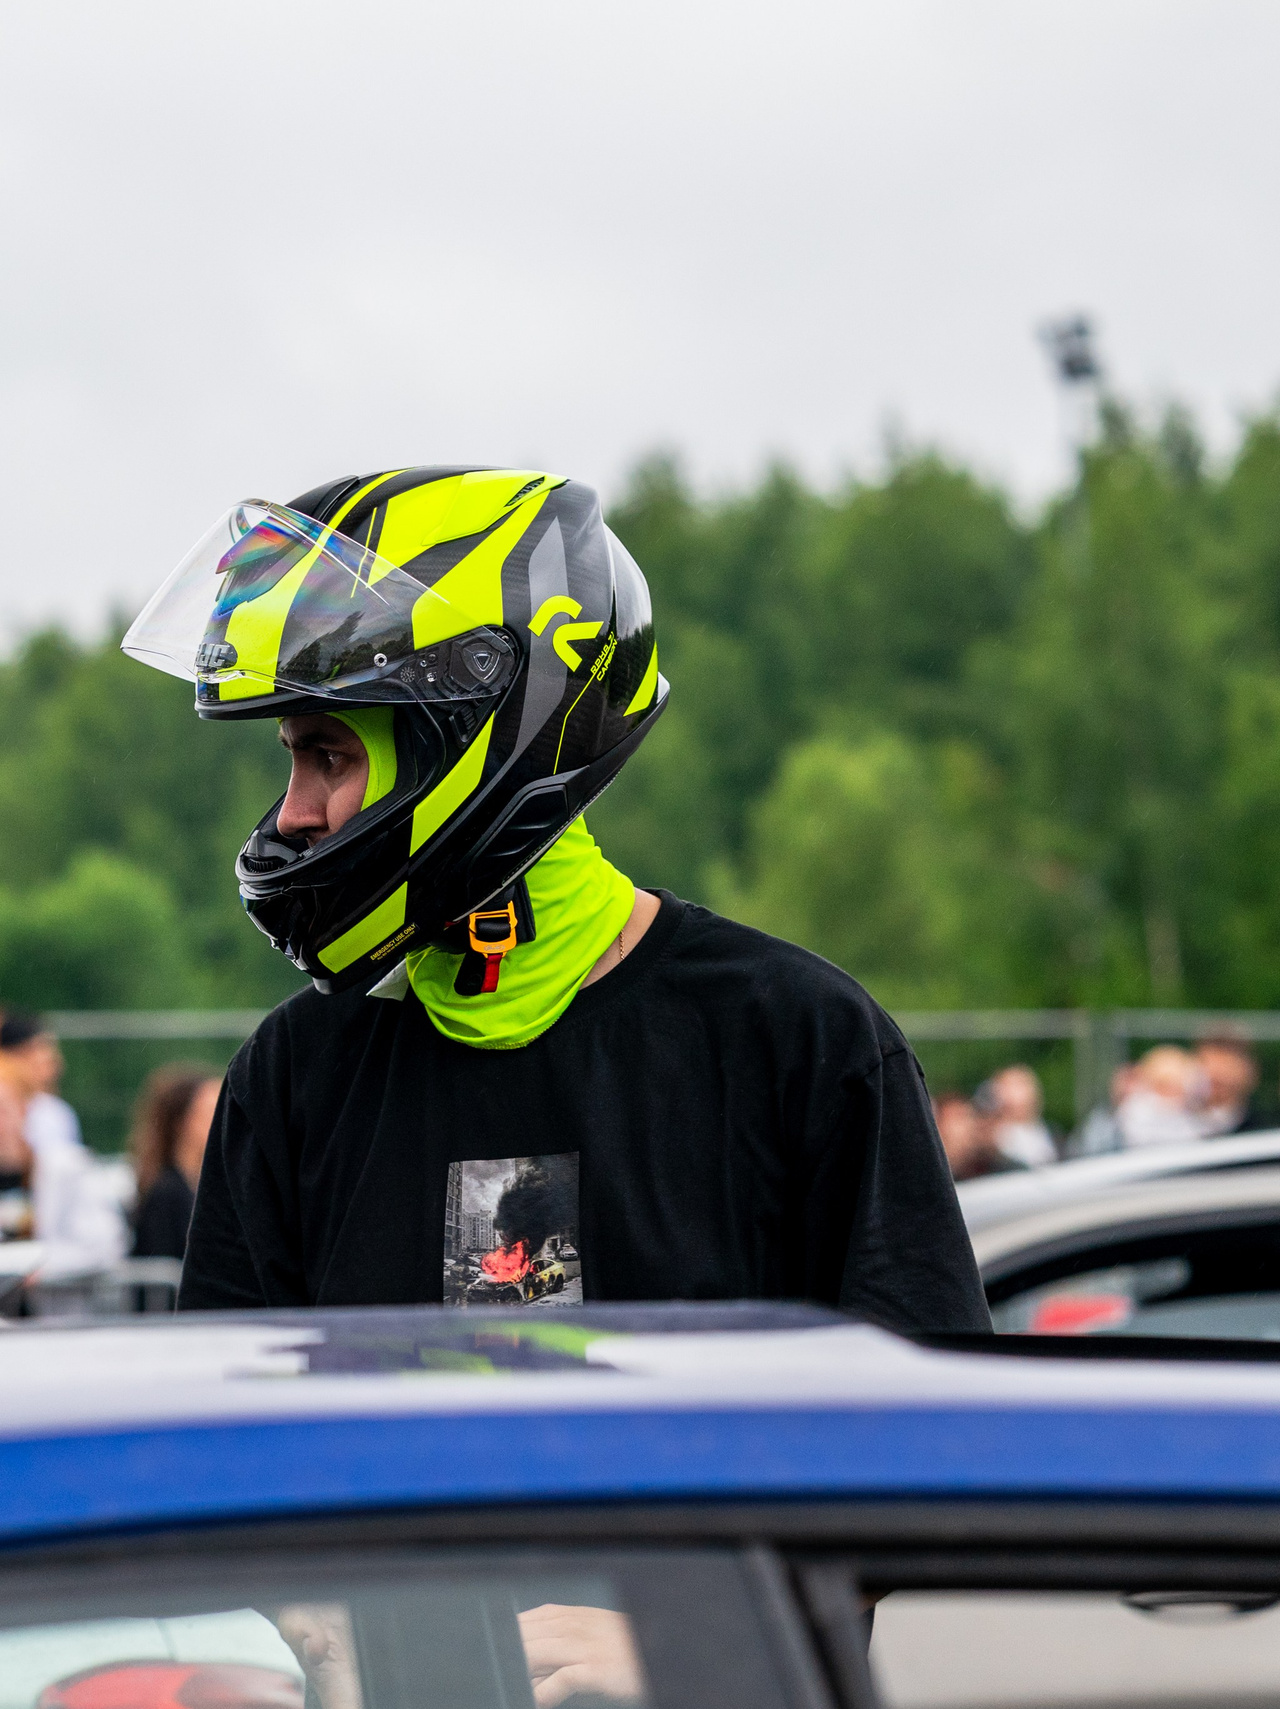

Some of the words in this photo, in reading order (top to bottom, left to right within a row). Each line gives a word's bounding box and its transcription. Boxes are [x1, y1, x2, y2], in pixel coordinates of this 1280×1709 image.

[596, 639, 617, 681] CARBON
[394, 932, 405, 941] USE
[403, 922, 415, 934] ONLY
